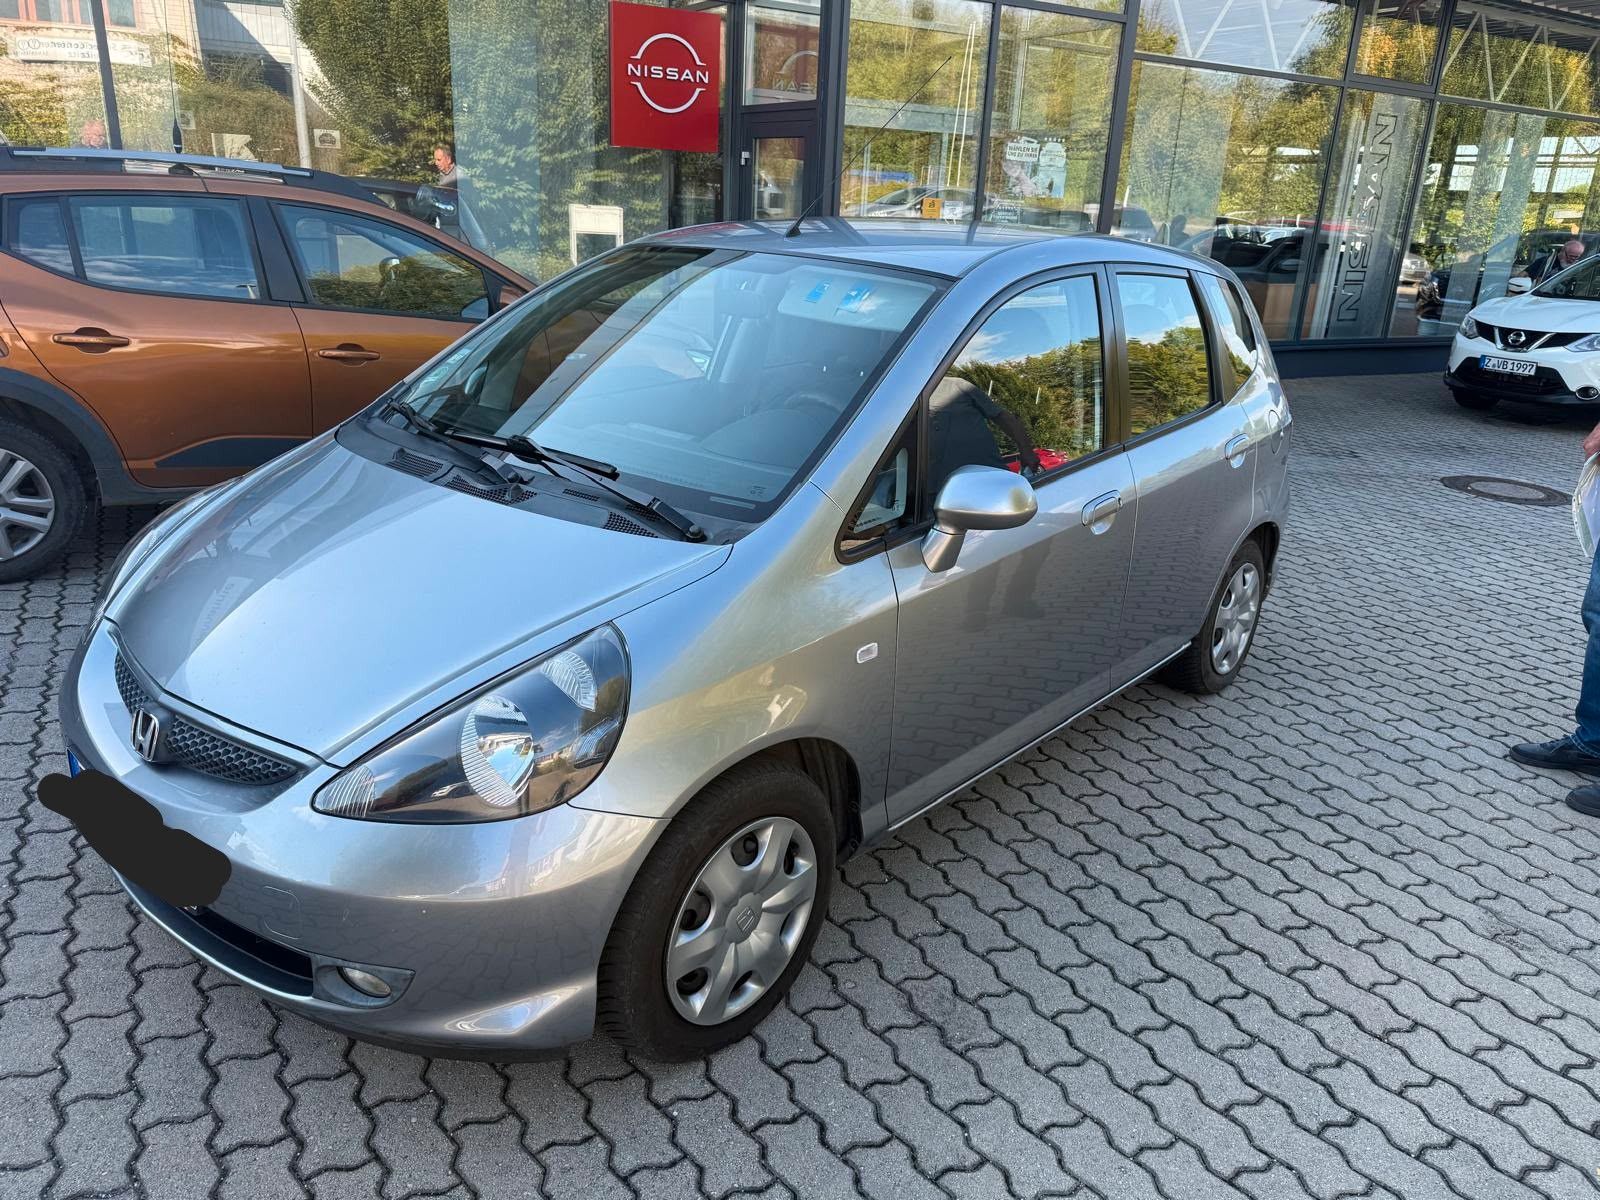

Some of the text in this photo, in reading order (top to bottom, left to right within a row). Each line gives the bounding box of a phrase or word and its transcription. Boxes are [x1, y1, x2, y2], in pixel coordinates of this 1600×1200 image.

[627, 63, 709, 84] NISSAN
[1337, 113, 1398, 322] NISSAN
[1485, 358, 1534, 373] Z VB 1997
